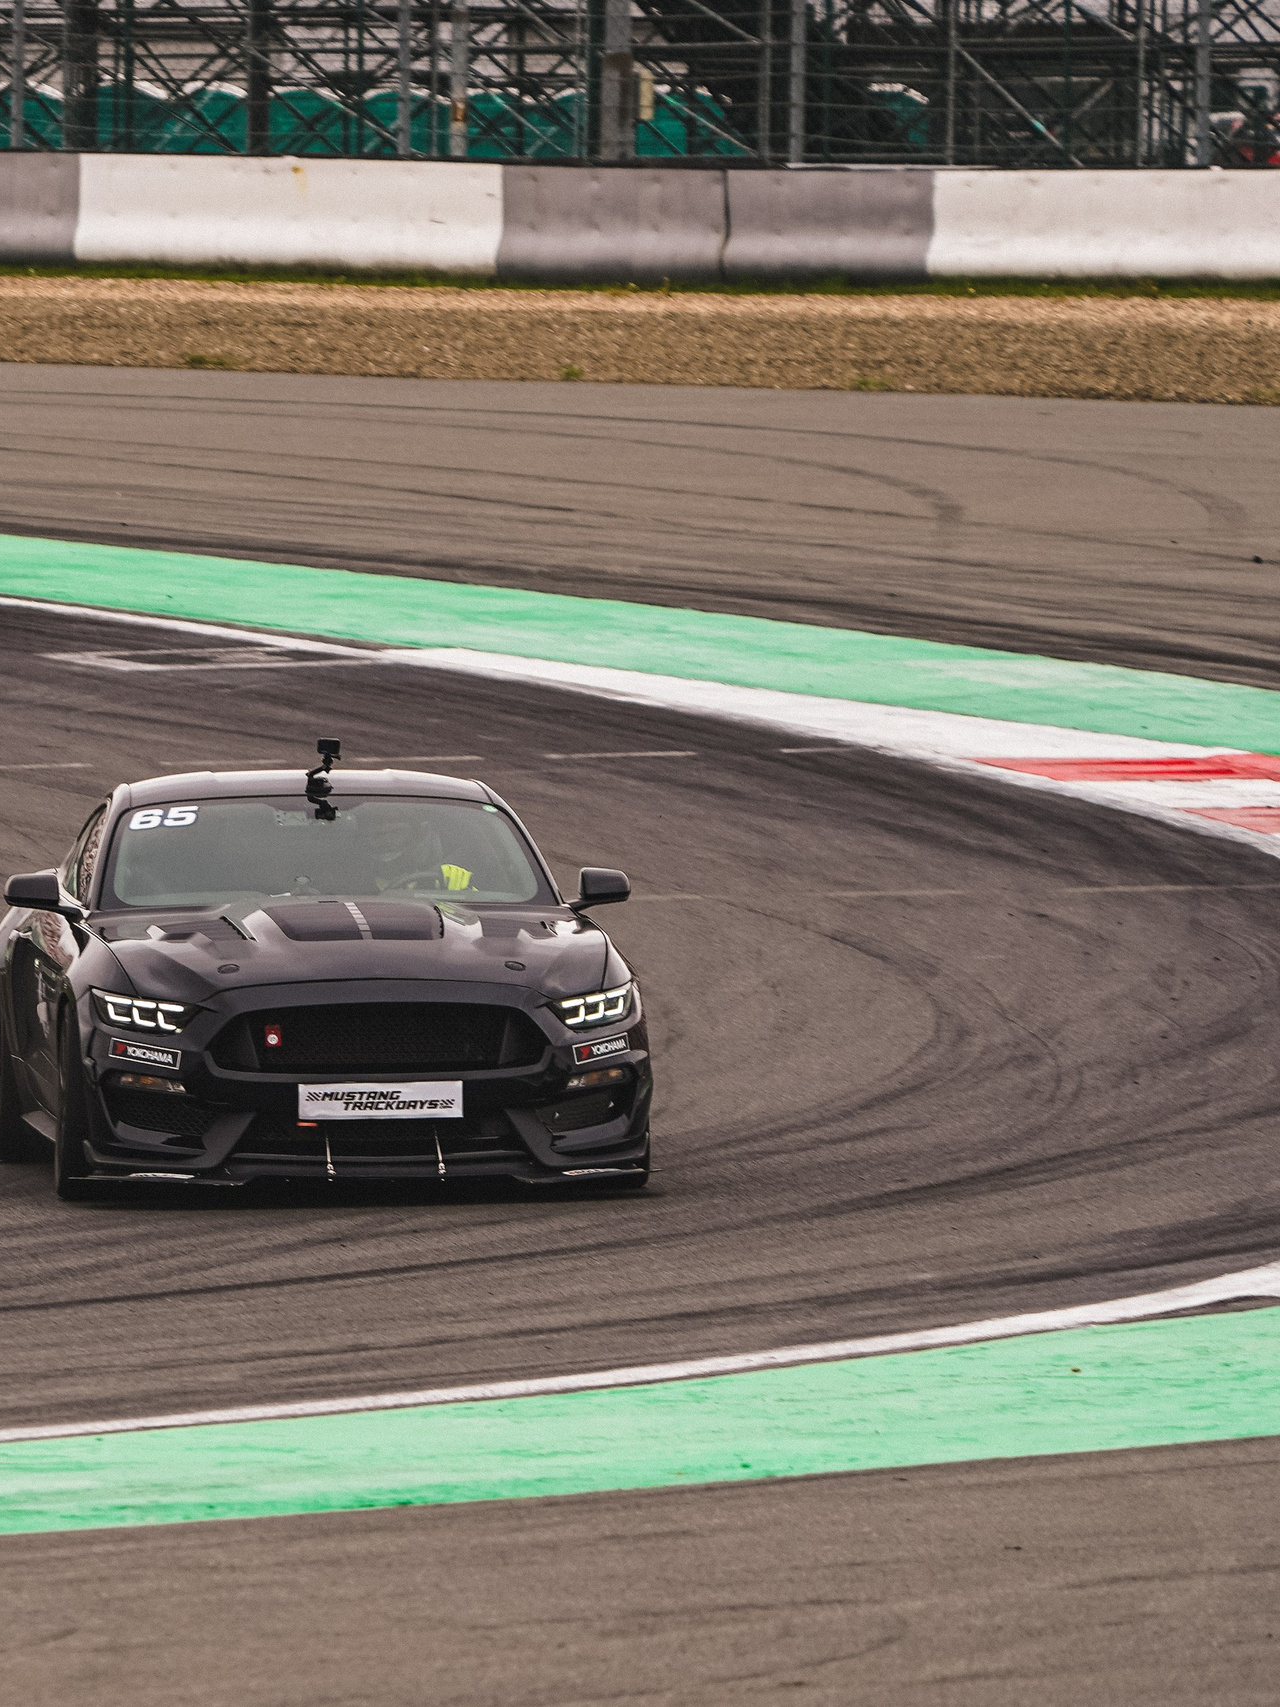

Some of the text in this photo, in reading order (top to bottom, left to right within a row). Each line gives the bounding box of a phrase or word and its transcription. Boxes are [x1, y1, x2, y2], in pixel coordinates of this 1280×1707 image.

[128, 805, 200, 831] 65
[126, 1045, 174, 1065] YOKOHAMA
[590, 1038, 627, 1056] YOKOHAMA
[320, 1090, 402, 1102] MUSTANG
[343, 1099, 440, 1112] TRACKDAYS
